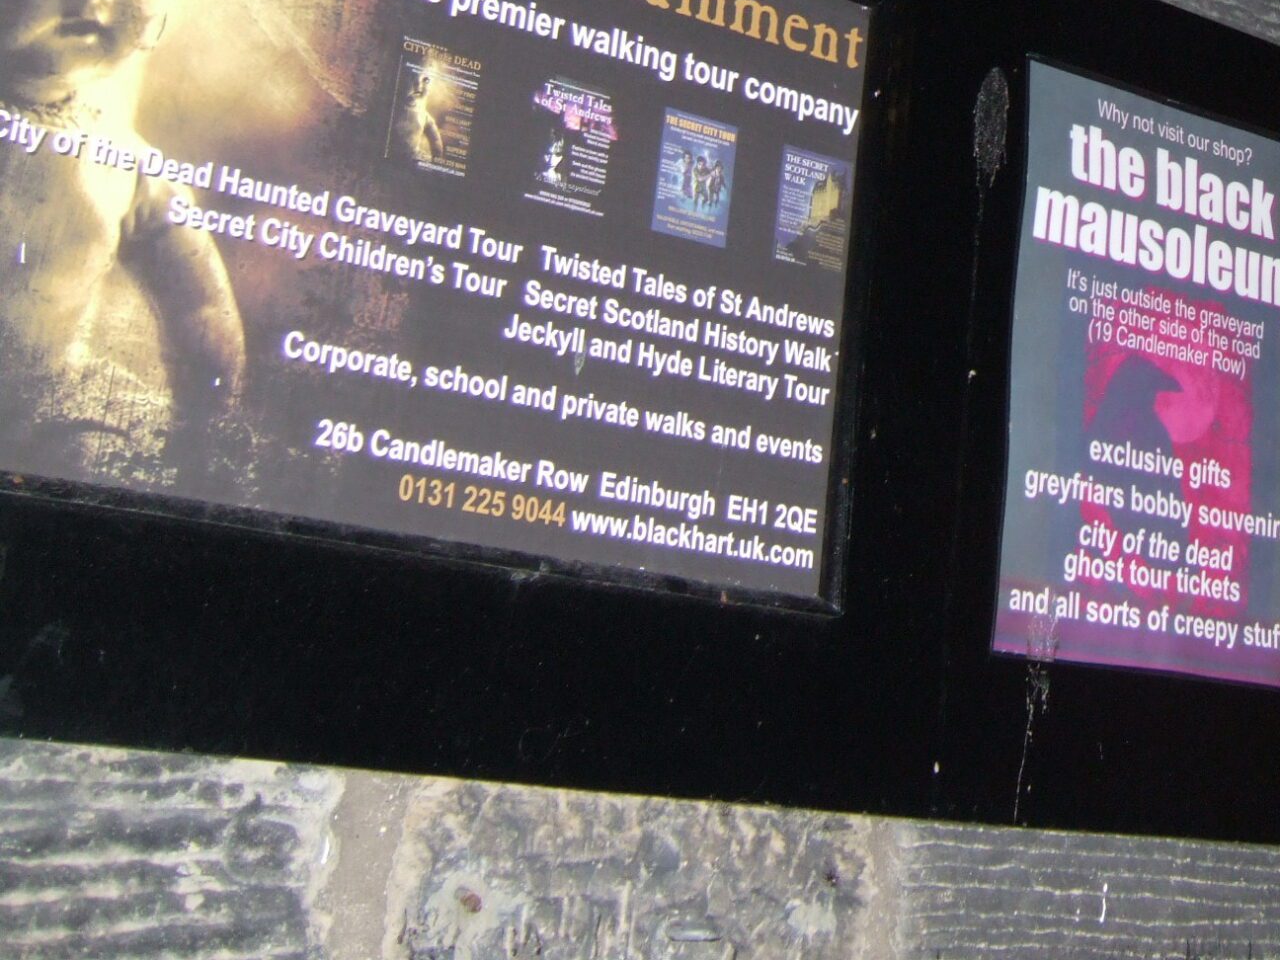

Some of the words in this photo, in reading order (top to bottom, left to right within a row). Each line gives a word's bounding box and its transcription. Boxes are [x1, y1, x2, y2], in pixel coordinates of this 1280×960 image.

[545, 83, 584, 104] Twisted
[586, 96, 612, 113] Tales
[571, 19, 677, 82] walking
[684, 53, 738, 93] tour
[743, 74, 860, 136] company
[571, 104, 612, 124] Andrews
[1098, 98, 1129, 131] Why
[1133, 112, 1154, 135] not
[1157, 120, 1185, 145] visit
[1187, 134, 1209, 153] our
[1212, 138, 1252, 166] shop?
[0, 109, 48, 153] City
[53, 133, 87, 158] of
[89, 138, 136, 170] the
[141, 147, 213, 188] Dead
[219, 165, 330, 216] Haunted
[335, 196, 462, 249] Graveyard
[469, 227, 523, 263] Tour
[1070, 124, 1145, 198] the
[1156, 148, 1275, 240] black
[168, 196, 256, 240] Secret
[261, 217, 314, 258] City
[319, 232, 445, 284] Children's
[452, 262, 507, 298] Tour
[525, 279, 598, 319] Secret
[603, 298, 699, 342] Scotland
[704, 321, 779, 365] History
[784, 339, 831, 372] Walk
[541, 245, 626, 288] Twisted
[632, 267, 687, 303] Tales
[693, 286, 716, 309] of
[720, 290, 742, 317] St
[746, 296, 835, 337] Andrews
[1067, 268, 1087, 293] It's
[1090, 275, 1118, 299] just
[1121, 285, 1172, 314] outside
[1175, 298, 1196, 320] the
[1200, 307, 1264, 339] graveyard
[504, 314, 585, 356] Jeckyll
[590, 337, 632, 364] and
[638, 342, 693, 376] Hyde
[698, 356, 779, 400] Literary
[784, 374, 830, 405] Tour
[1069, 297, 1088, 315] on
[1092, 300, 1115, 323] the
[1119, 307, 1156, 330] other
[1159, 316, 1187, 339] side
[1190, 325, 1205, 343] of
[1207, 327, 1229, 350] the
[1232, 337, 1261, 359] road
[1089, 319, 1112, 343] (19
[1116, 326, 1209, 366] Candlemaker
[1211, 352, 1246, 380] Row)
[284, 330, 418, 387] Corporate,
[424, 365, 508, 401] school
[512, 386, 557, 411] and
[561, 393, 639, 427] private
[645, 410, 705, 440] walks
[711, 423, 751, 449] and
[756, 433, 823, 463] events
[315, 419, 364, 452] 26b
[370, 429, 532, 483] Candlemaker
[537, 459, 589, 493] Row
[600, 471, 715, 519] Edinburgh
[728, 495, 767, 525] EH1
[774, 504, 817, 533] 2QE
[1024, 468, 1125, 509] greyfriars
[1131, 485, 1193, 527] bobby
[1089, 439, 1184, 479] exclusive
[1189, 458, 1231, 489] gifts
[399, 474, 455, 508] 0131
[462, 486, 505, 517] 225
[511, 494, 566, 527] 9044
[572, 510, 814, 569] www.blackhart.uk.com
[1079, 520, 1117, 556] city
[1122, 529, 1146, 555] of
[1148, 533, 1180, 562] the
[1185, 539, 1234, 571] dead
[1064, 551, 1124, 583] ghost
[1129, 560, 1171, 589] tour
[1176, 569, 1240, 602] tickets
[1009, 588, 1049, 615] and
[1055, 591, 1080, 619] all
[1086, 599, 1141, 628] sorts
[1147, 606, 1169, 632] of
[1174, 613, 1238, 649] creepy
